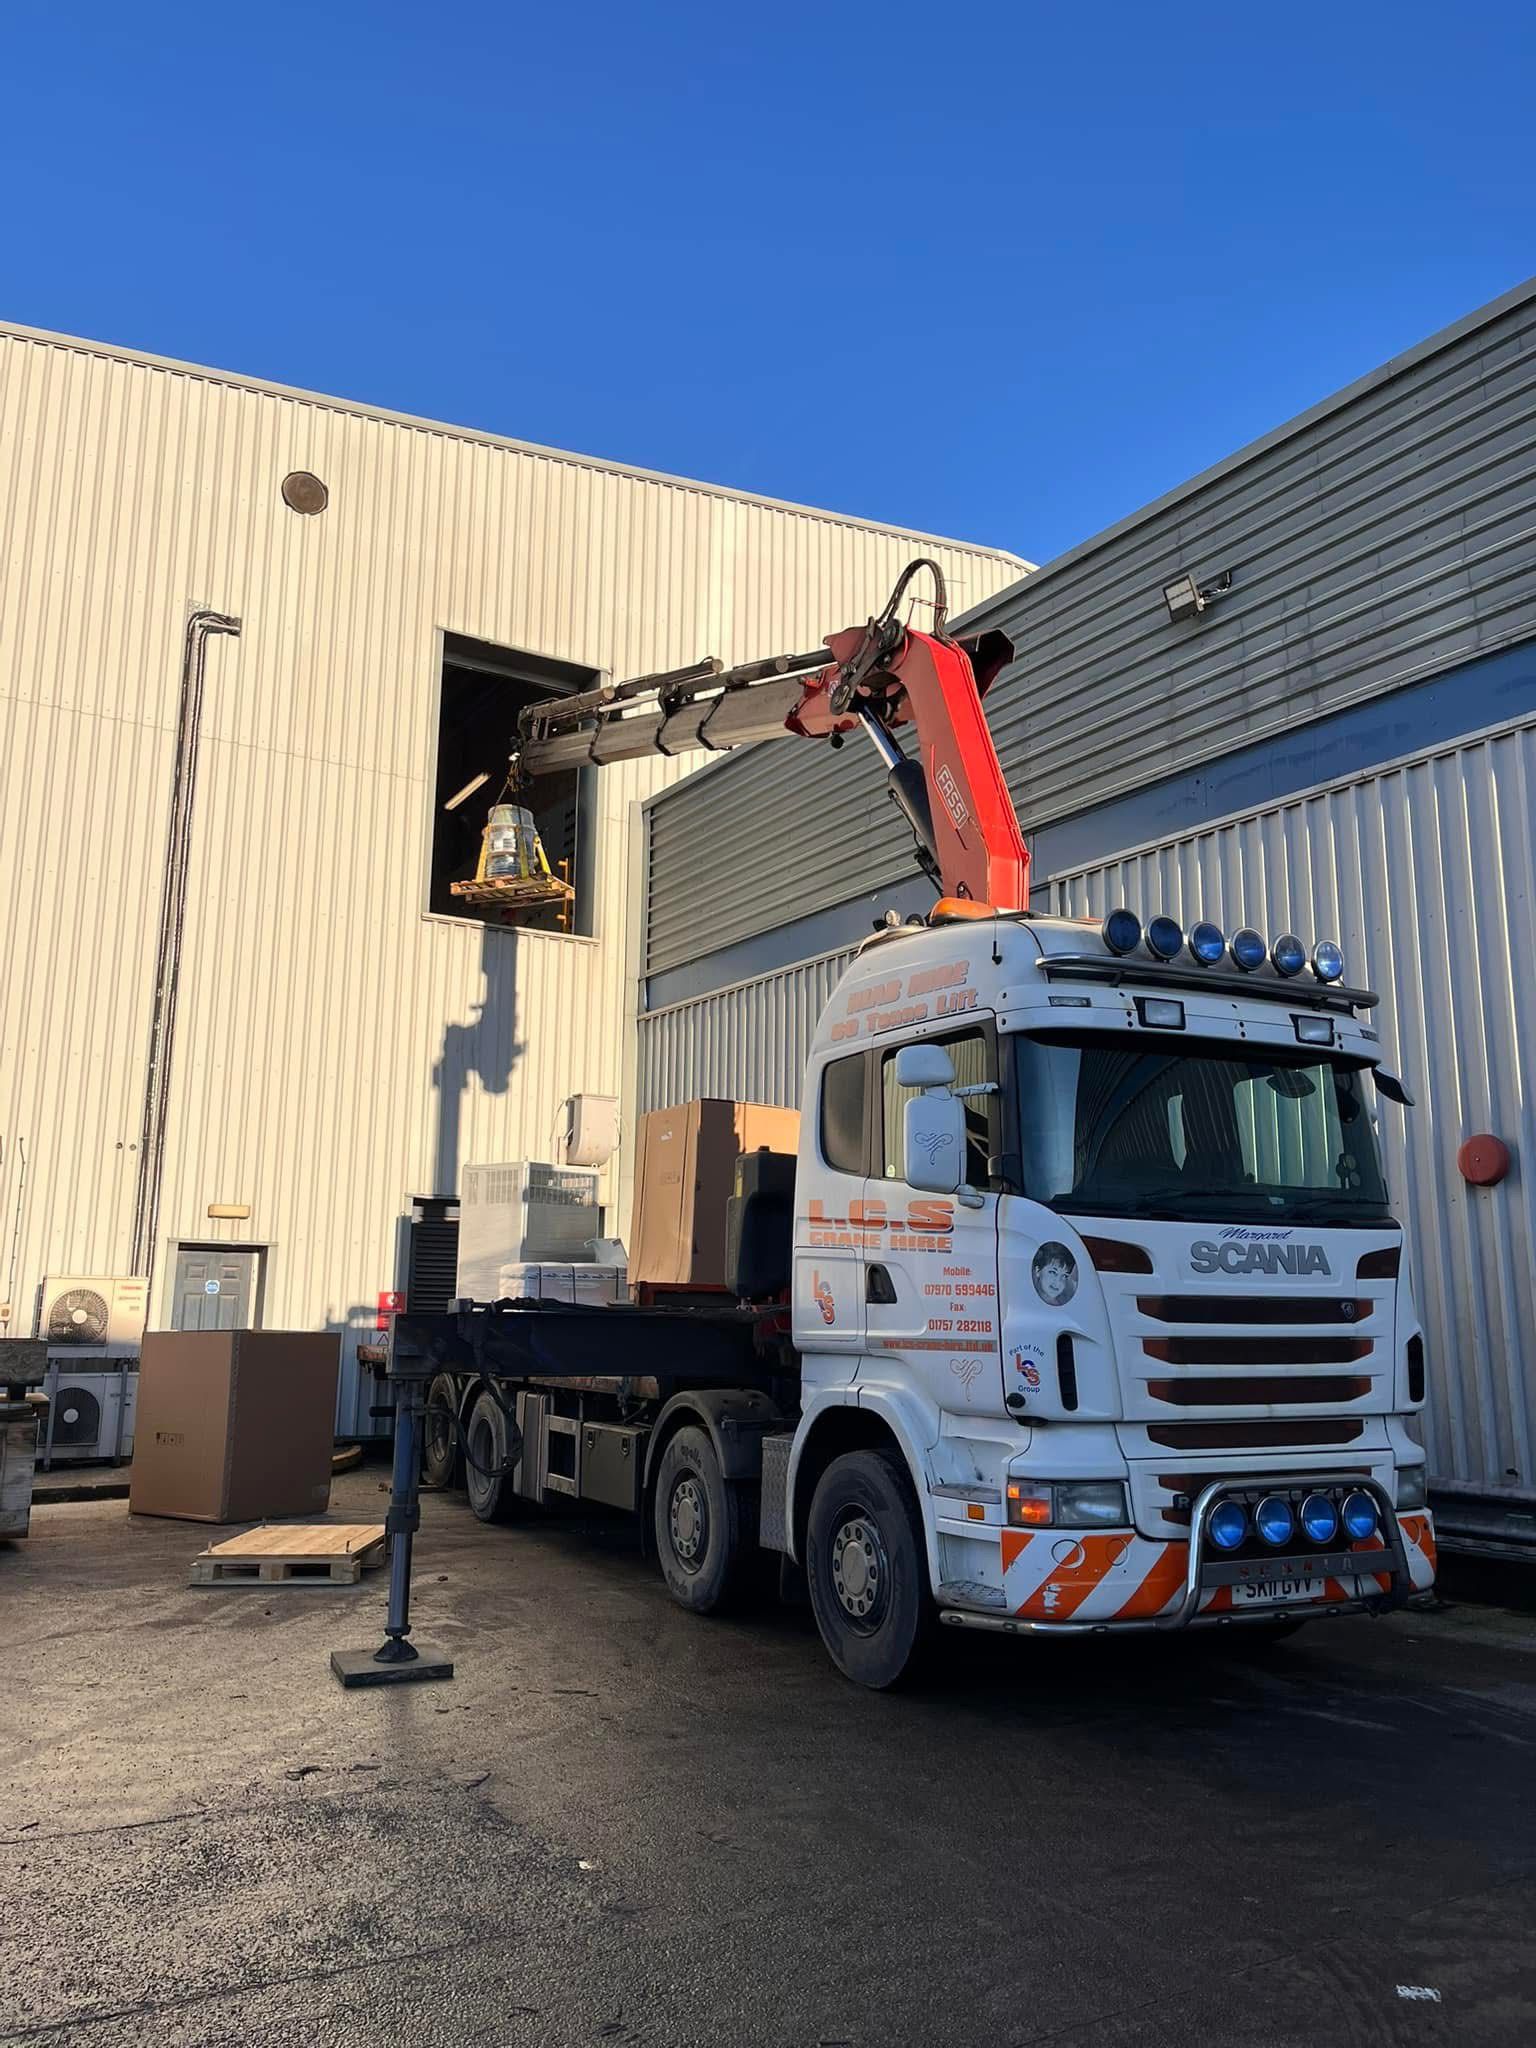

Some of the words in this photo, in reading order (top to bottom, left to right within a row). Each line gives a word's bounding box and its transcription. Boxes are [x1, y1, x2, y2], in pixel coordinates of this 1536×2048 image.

[937, 769, 968, 824] FASSI
[1218, 1226, 1294, 1242] Margaret
[809, 1231, 881, 1249] CRANE
[890, 1235, 952, 1253] HIRE
[1190, 1240, 1332, 1276] SCANIA
[924, 1283, 951, 1297] 07970
[955, 1283, 996, 1297] 599446
[928, 1319, 954, 1332] 01757
[956, 1319, 992, 1333] 282118
[1008, 1344, 1023, 1357] Part
[1033, 1345, 1045, 1357] the
[1017, 1384, 1041, 1394] Group
